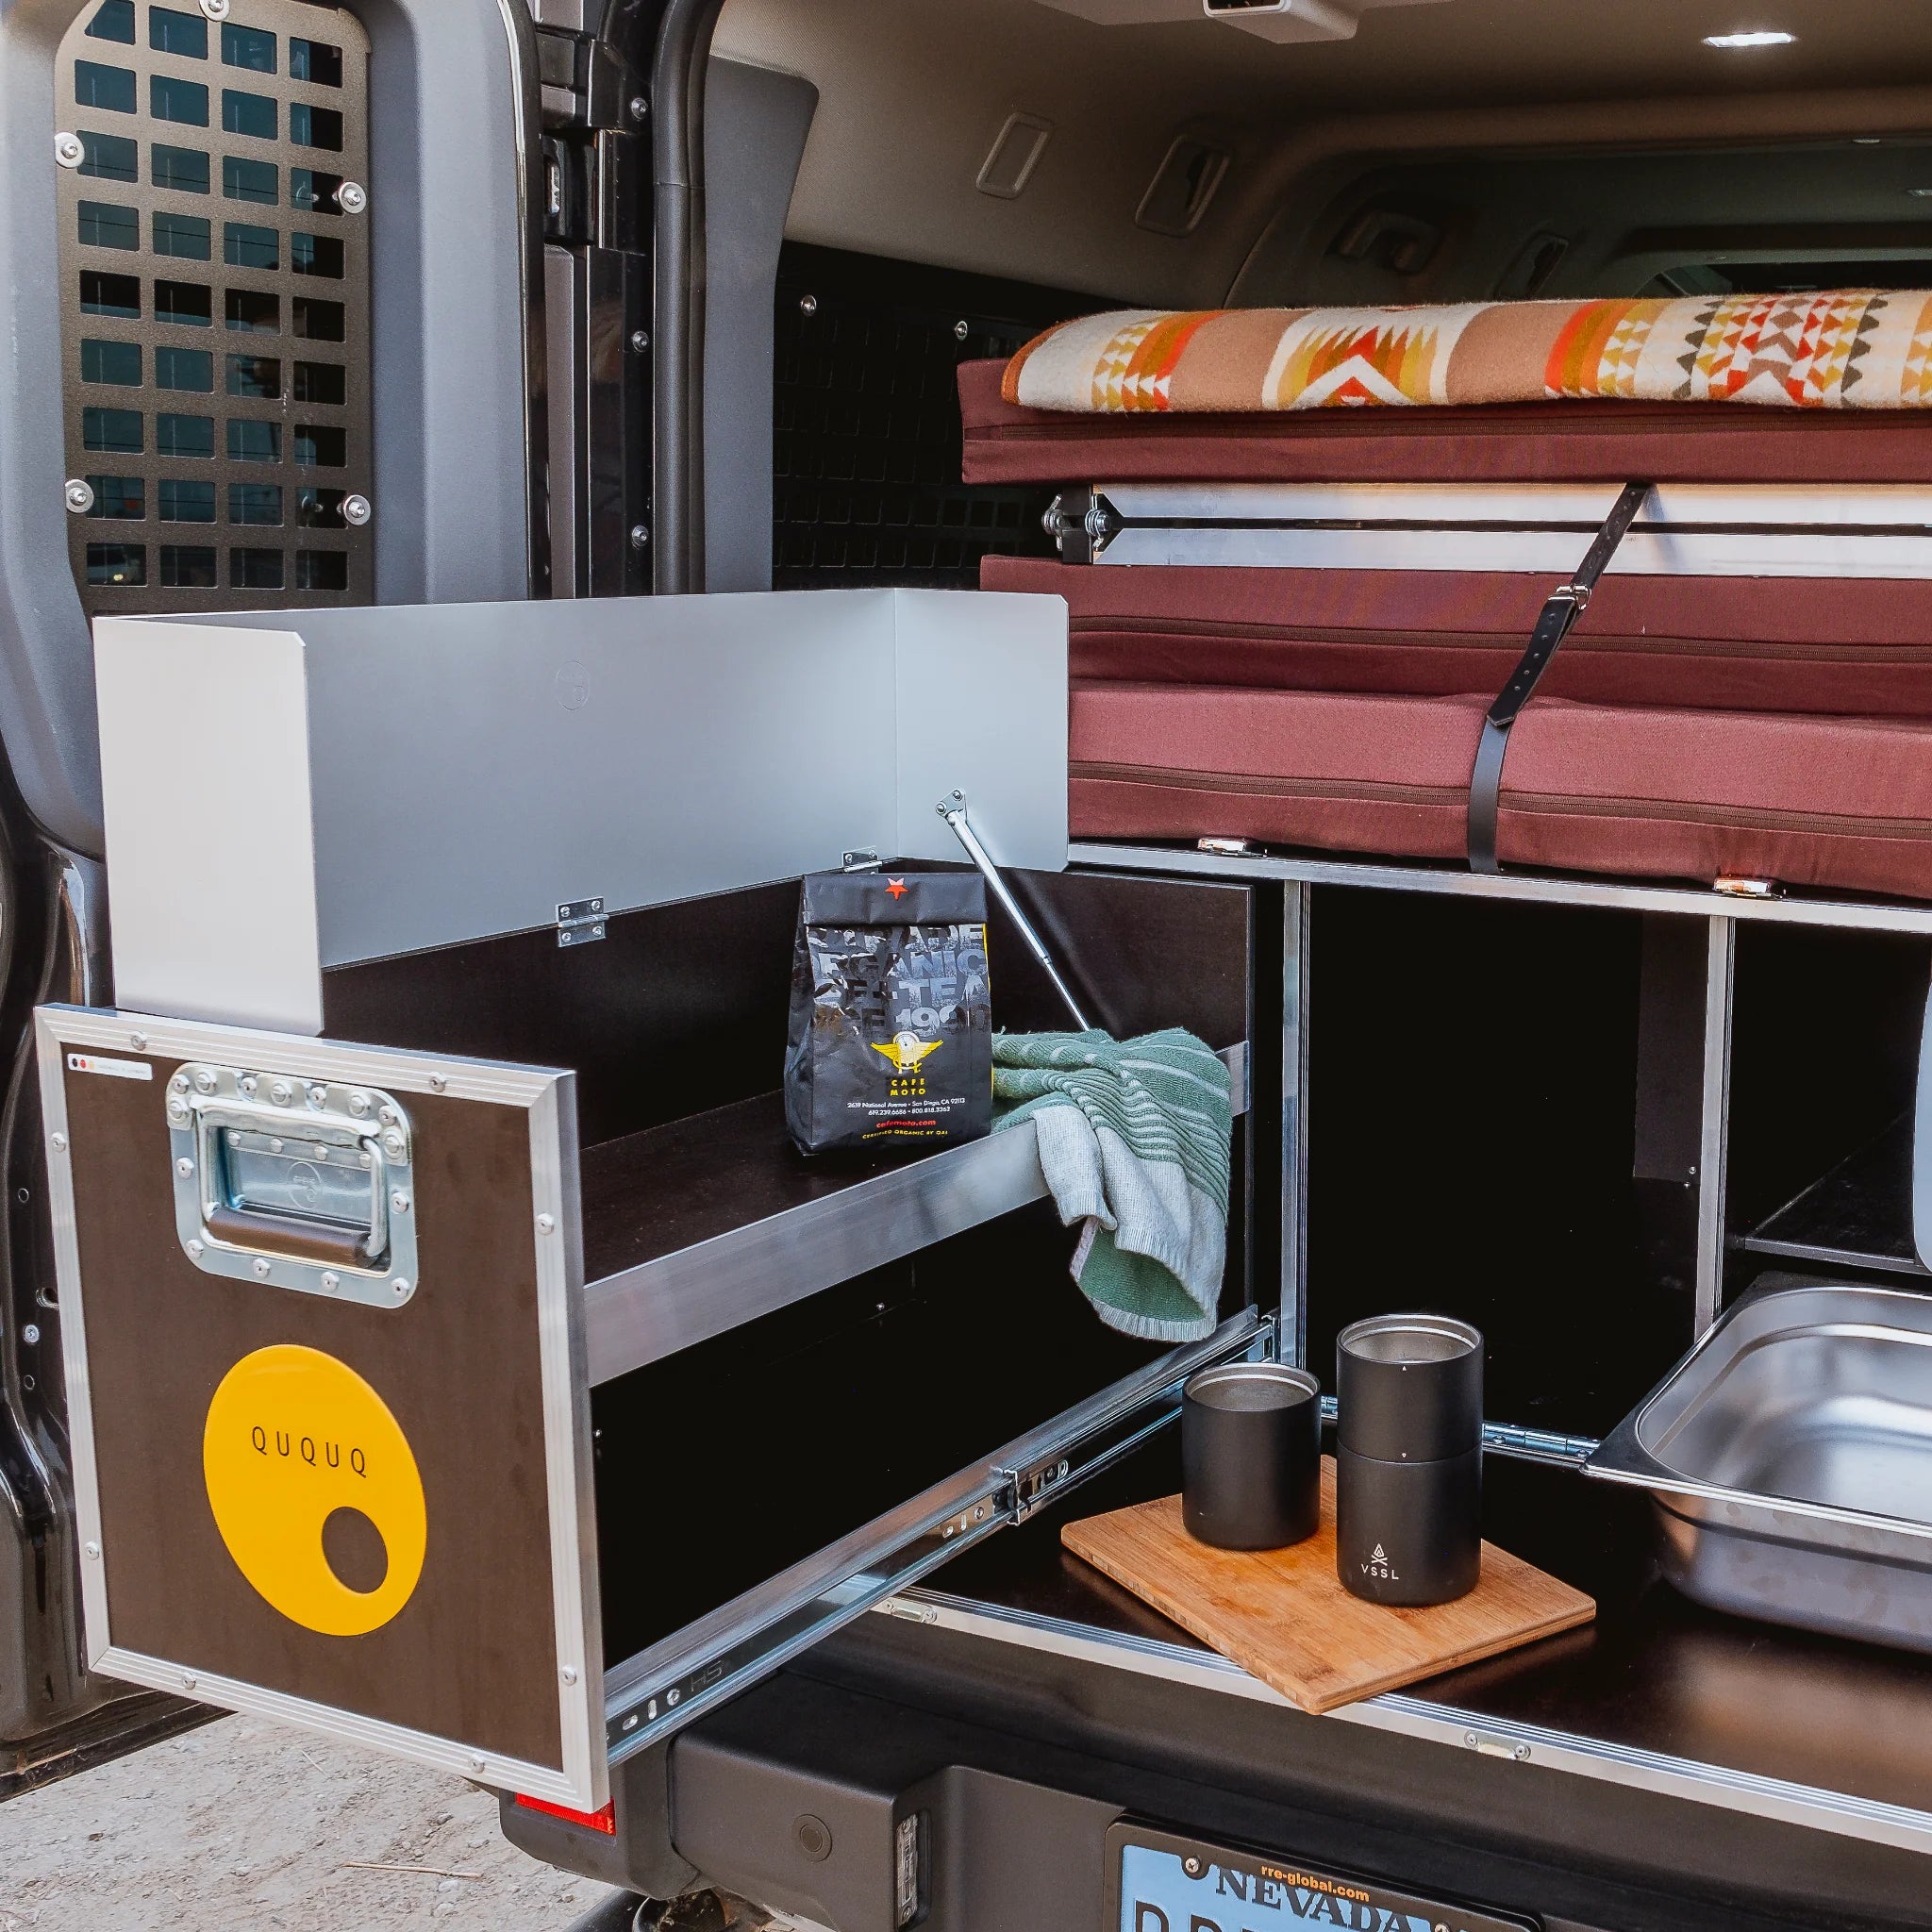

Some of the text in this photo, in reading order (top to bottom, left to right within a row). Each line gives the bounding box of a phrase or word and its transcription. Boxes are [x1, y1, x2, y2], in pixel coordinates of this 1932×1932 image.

[891, 1077, 925, 1087] CAFE
[890, 1088, 926, 1097] MOTO
[875, 1120, 937, 1128] cafemoto.com
[252, 1425, 367, 1478] QUQUQ
[1360, 1563, 1400, 1580] VSSL
[1261, 1864, 1370, 1903] rre-global.com
[1215, 1866, 1413, 1932] NEVADA
